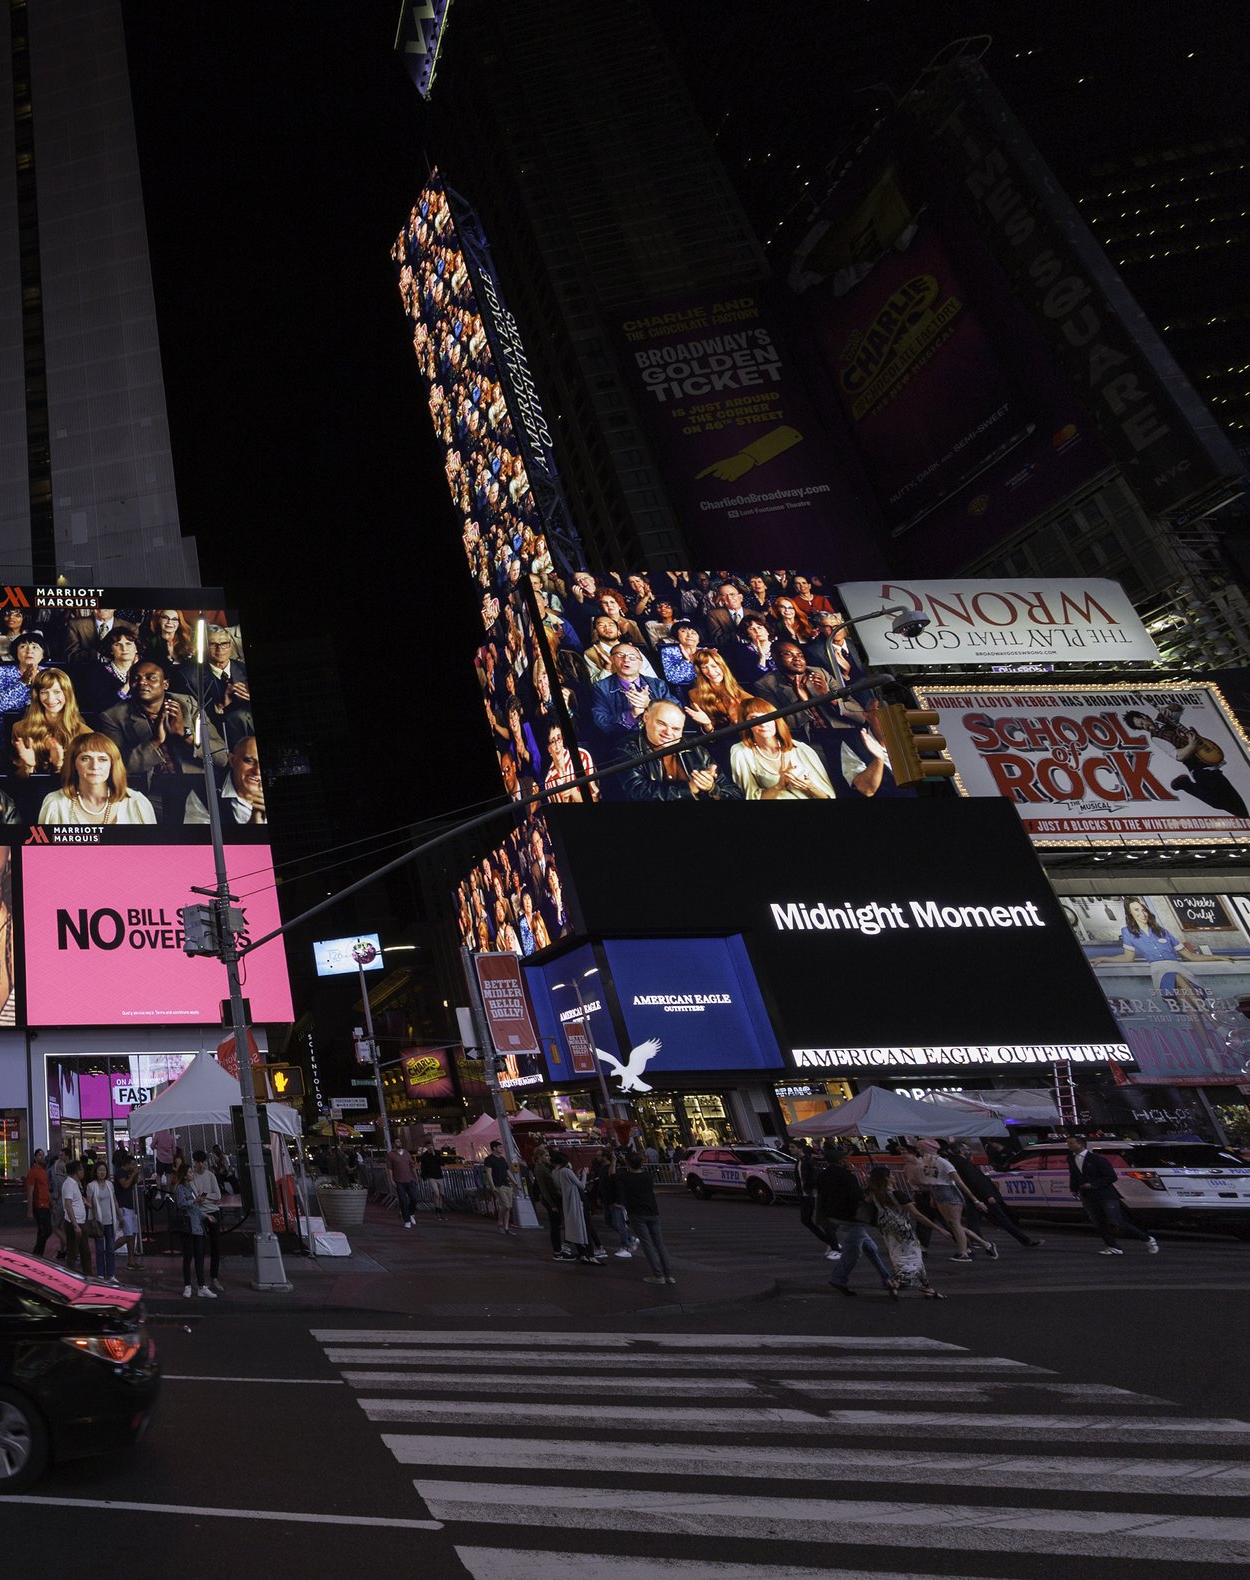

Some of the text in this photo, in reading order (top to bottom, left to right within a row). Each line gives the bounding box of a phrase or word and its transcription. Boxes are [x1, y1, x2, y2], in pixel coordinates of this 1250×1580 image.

[622, 297, 755, 332] CHARLIE AND
[648, 318, 709, 338] CHOCOLATE
[711, 307, 760, 325] FACTORY
[634, 328, 771, 368] BROADWAY'S
[641, 345, 780, 384] GOLDEN
[646, 362, 783, 402] TICKET
[672, 391, 780, 418] IS JUST AROUND
[688, 403, 770, 424] THE CORNER
[682, 426, 702, 436] ON
[735, 410, 783, 427] STREET
[700, 484, 831, 511] CharlieOnBroadway.com
[36, 588, 104, 598] MARRIOTT
[36, 598, 99, 609] MARQUIS
[878, 583, 1121, 628] WRONG
[885, 628, 1134, 650] THE PLAY THAT GOES
[927, 695, 974, 709] ANDREW
[977, 696, 1012, 708] LLOYD
[1012, 695, 1061, 708] WEBBER
[1060, 696, 1083, 707] HAS
[962, 712, 1150, 750] SCHOOL
[1052, 743, 1083, 770] of
[979, 750, 1181, 804] ROCK
[1079, 803, 1112, 812] MUSICAL
[53, 827, 105, 835] MARRIOTT
[1038, 822, 1062, 831] JUST
[1063, 821, 1070, 830] 4
[1071, 820, 1107, 831] BLOCKS
[1108, 820, 1122, 830] TO
[1124, 819, 1145, 829] THE
[53, 835, 101, 844] MARQUIS
[127, 909, 171, 926] BILL
[770, 899, 1046, 936] Midnight Moment
[1187, 908, 1216, 924] Only!
[56, 908, 126, 951] NO
[483, 979, 518, 989] BETTE
[483, 988, 522, 998] MIDLER
[633, 994, 732, 1006] AMERICAN EAGLE
[490, 1008, 524, 1019] DOLLY!
[793, 1043, 1133, 1067] AMERICAN EAGLE OUTFITTERS
[721, 1169, 740, 1179] NYPD
[1005, 1180, 1036, 1194] NYPD
